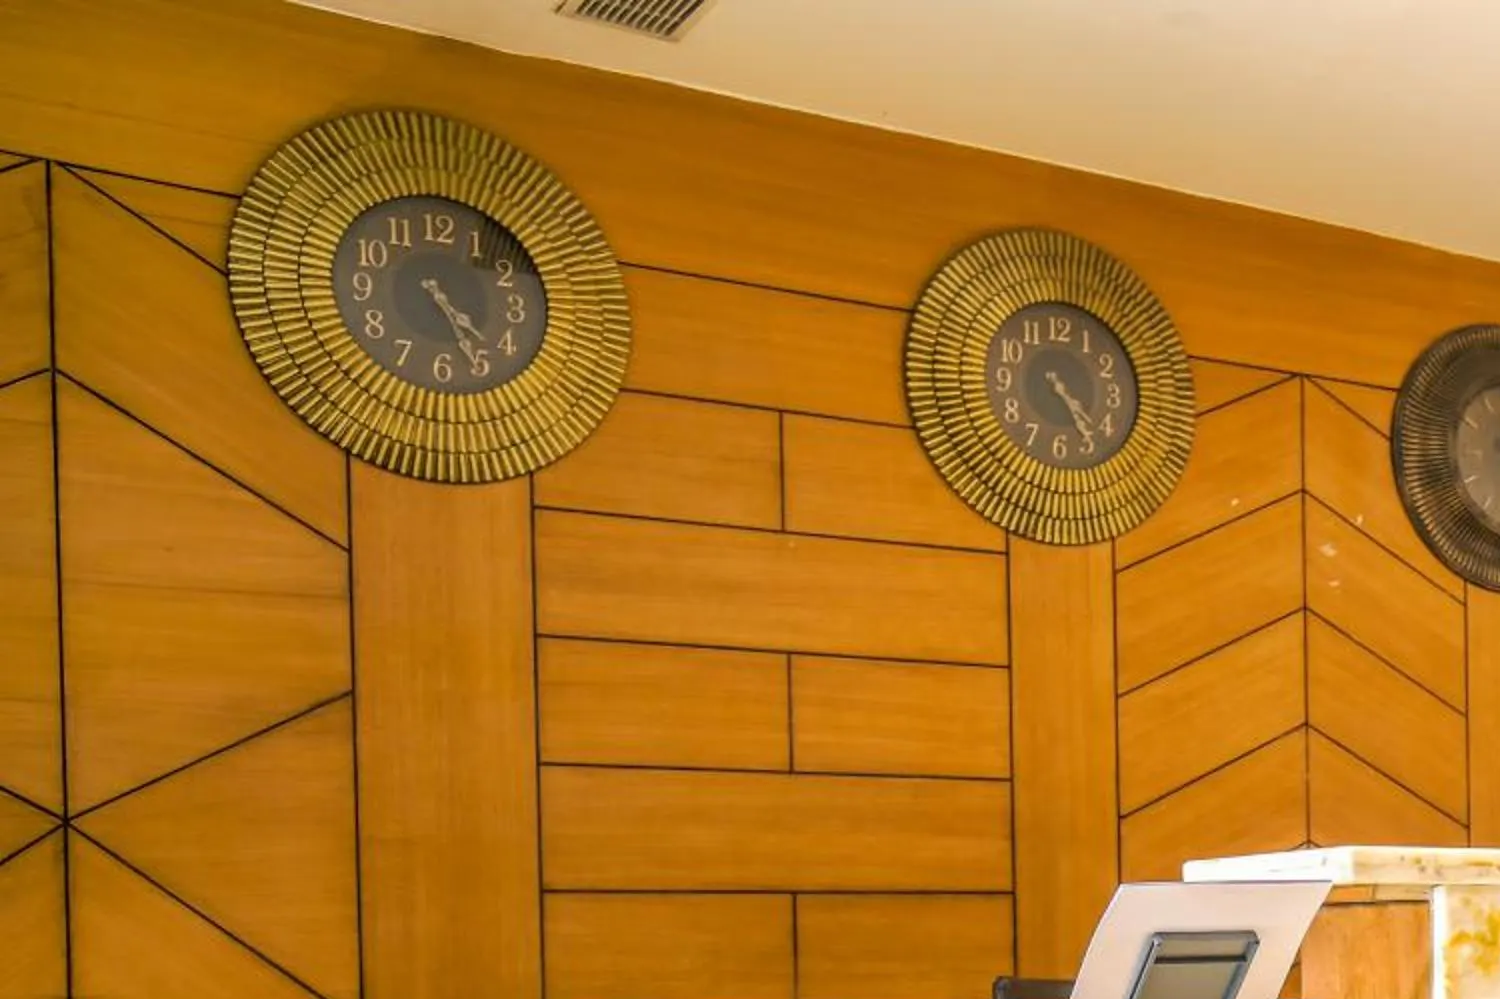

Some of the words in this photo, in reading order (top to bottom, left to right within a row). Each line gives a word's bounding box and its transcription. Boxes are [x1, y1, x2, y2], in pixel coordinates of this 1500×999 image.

[387, 217, 412, 248] 11
[423, 213, 455, 243] 12
[358, 239, 387, 268] 10
[470, 231, 482, 257] 1
[495, 259, 513, 287] 2
[353, 272, 372, 301] 9
[506, 294, 525, 323] 3
[364, 309, 384, 339] 8
[1023, 320, 1040, 345] 11
[1048, 317, 1071, 342] 12
[394, 339, 413, 367] 7
[497, 329, 517, 356] 4
[1001, 339, 1023, 364] 10
[1081, 329, 1090, 353] 1
[433, 353, 452, 382] 6
[470, 349, 490, 377] 5
[1099, 354, 1114, 378] 2
[996, 367, 1012, 392] 9
[1106, 383, 1121, 408] 3
[1005, 399, 1019, 423] 8
[1025, 423, 1040, 447] 7
[1099, 413, 1114, 437] 4
[1053, 434, 1067, 460] 6
[1079, 430, 1094, 455] 5
